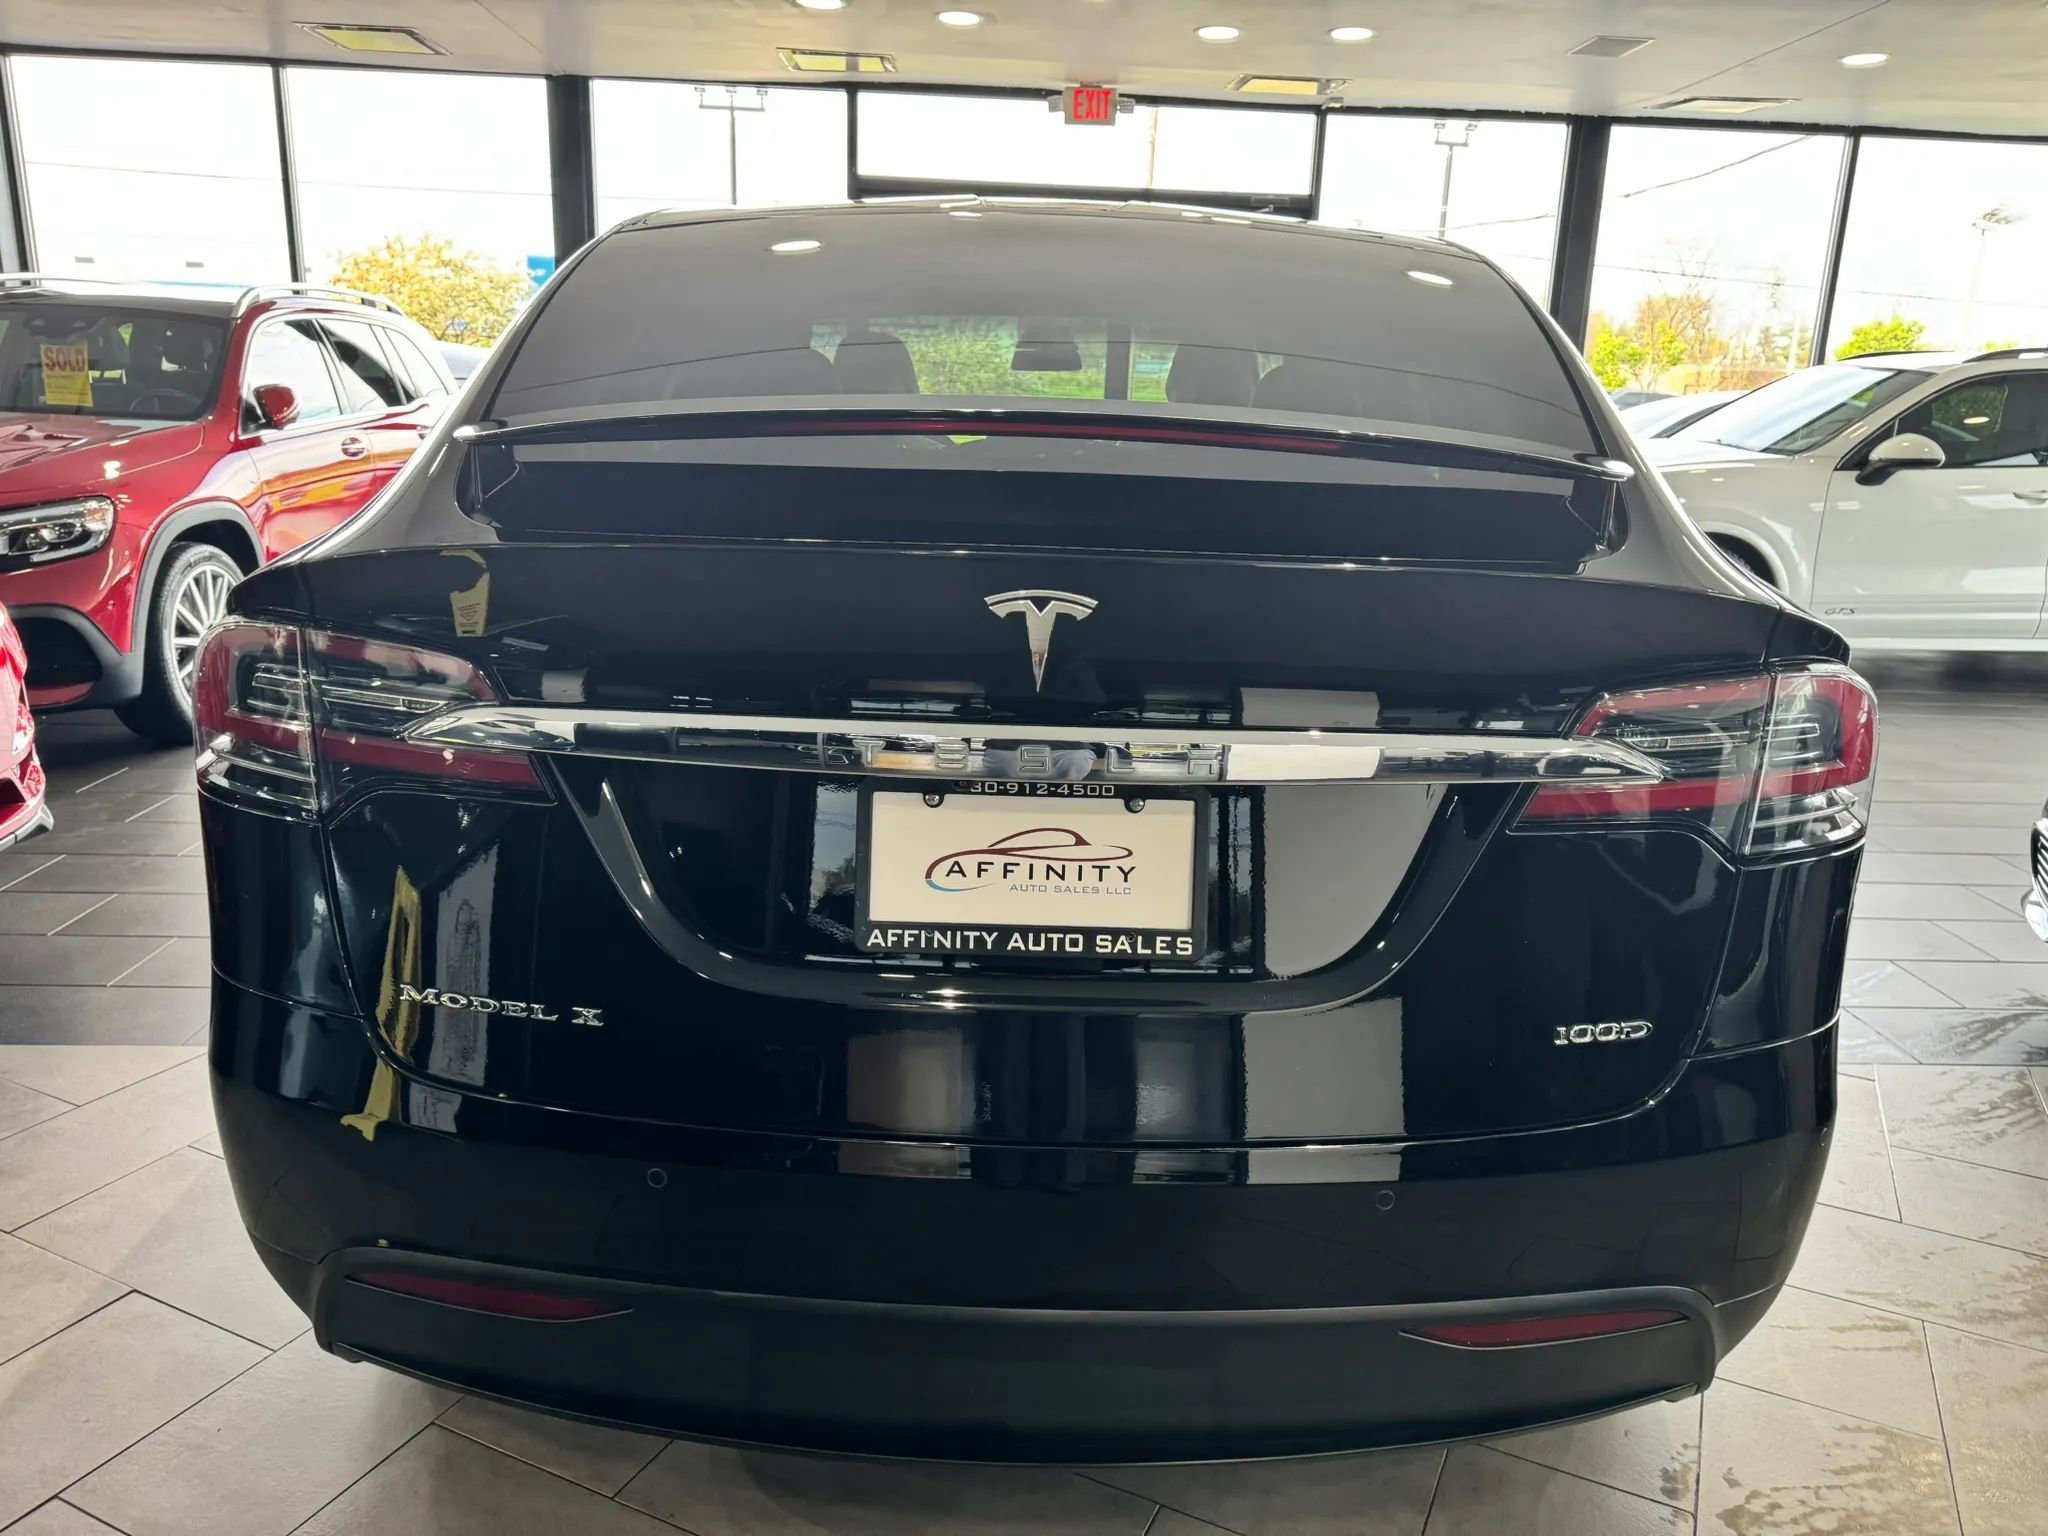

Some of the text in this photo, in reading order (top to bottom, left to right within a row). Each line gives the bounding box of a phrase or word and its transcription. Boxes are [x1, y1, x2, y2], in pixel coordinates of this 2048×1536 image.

[1073, 88, 1113, 121] EXIT
[43, 346, 86, 373] SOLD
[1823, 607, 1857, 616] GTS
[968, 781, 1115, 796] 30-912-4500
[945, 860, 1136, 883] AFFINITY
[1009, 883, 1132, 895] AUTO SALES LLC
[867, 929, 1193, 955] AFFINITY AUTO SALES
[400, 984, 604, 1027] MODEL X
[1554, 1020, 1653, 1045] 100D
